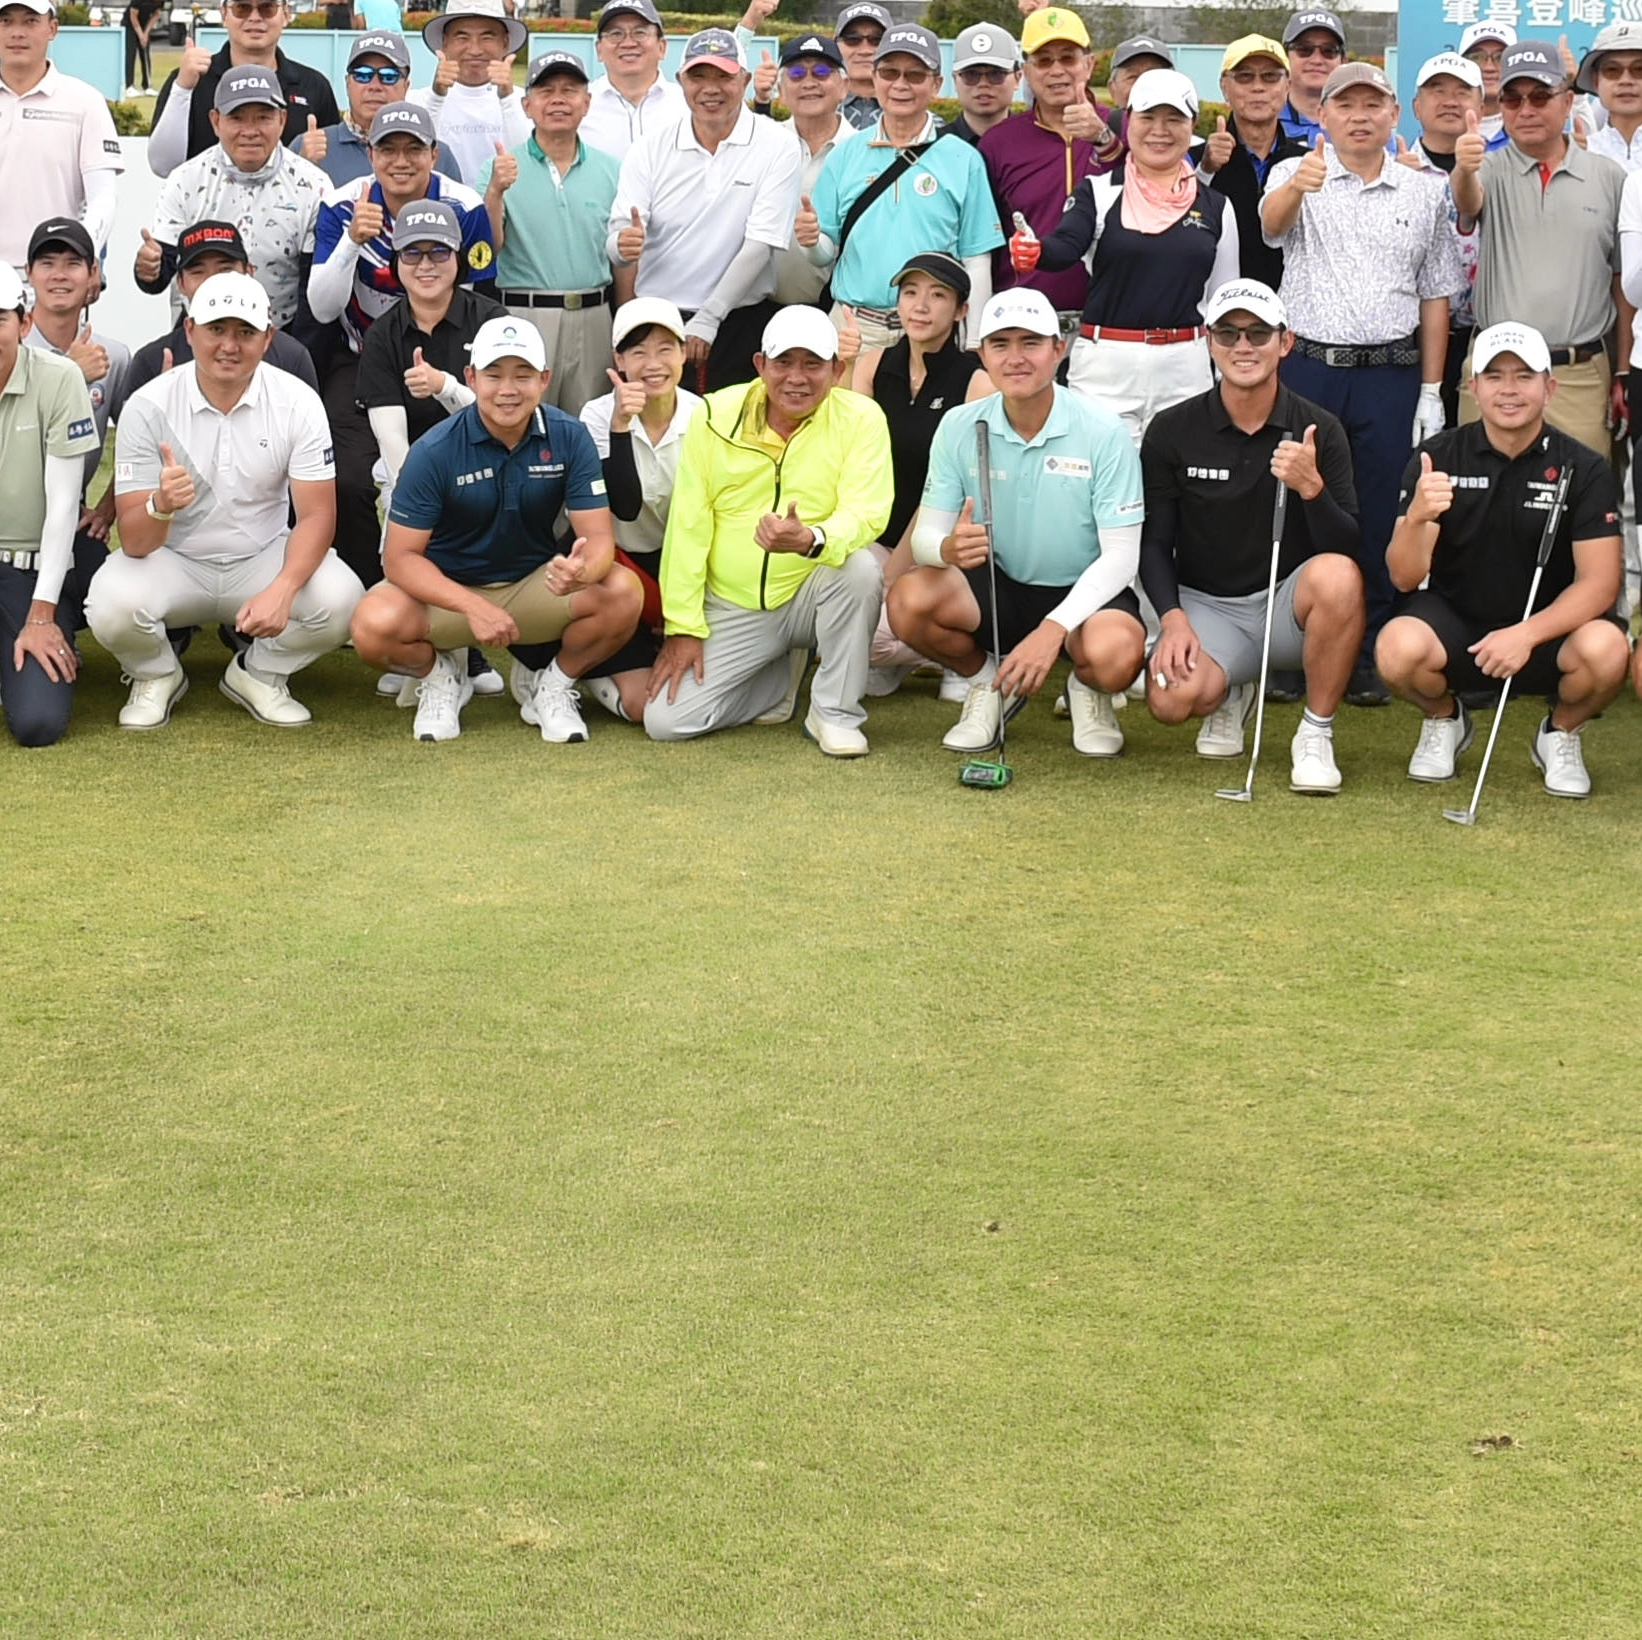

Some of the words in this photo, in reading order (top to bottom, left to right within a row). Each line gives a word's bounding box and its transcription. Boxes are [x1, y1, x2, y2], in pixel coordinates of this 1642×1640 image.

[847, 5, 883, 18] TPGA
[1299, 14, 1336, 28] TPGA
[1473, 26, 1506, 37] TPGA
[358, 36, 396, 50] TPGA
[890, 31, 929, 47] TPGA
[1433, 57, 1467, 69] TPGA
[1508, 51, 1549, 67] TPGA
[230, 77, 271, 92] TPGA
[382, 111, 422, 125] TPGA
[406, 212, 448, 226] TPGA
[1216, 288, 1271, 306] Titleist
